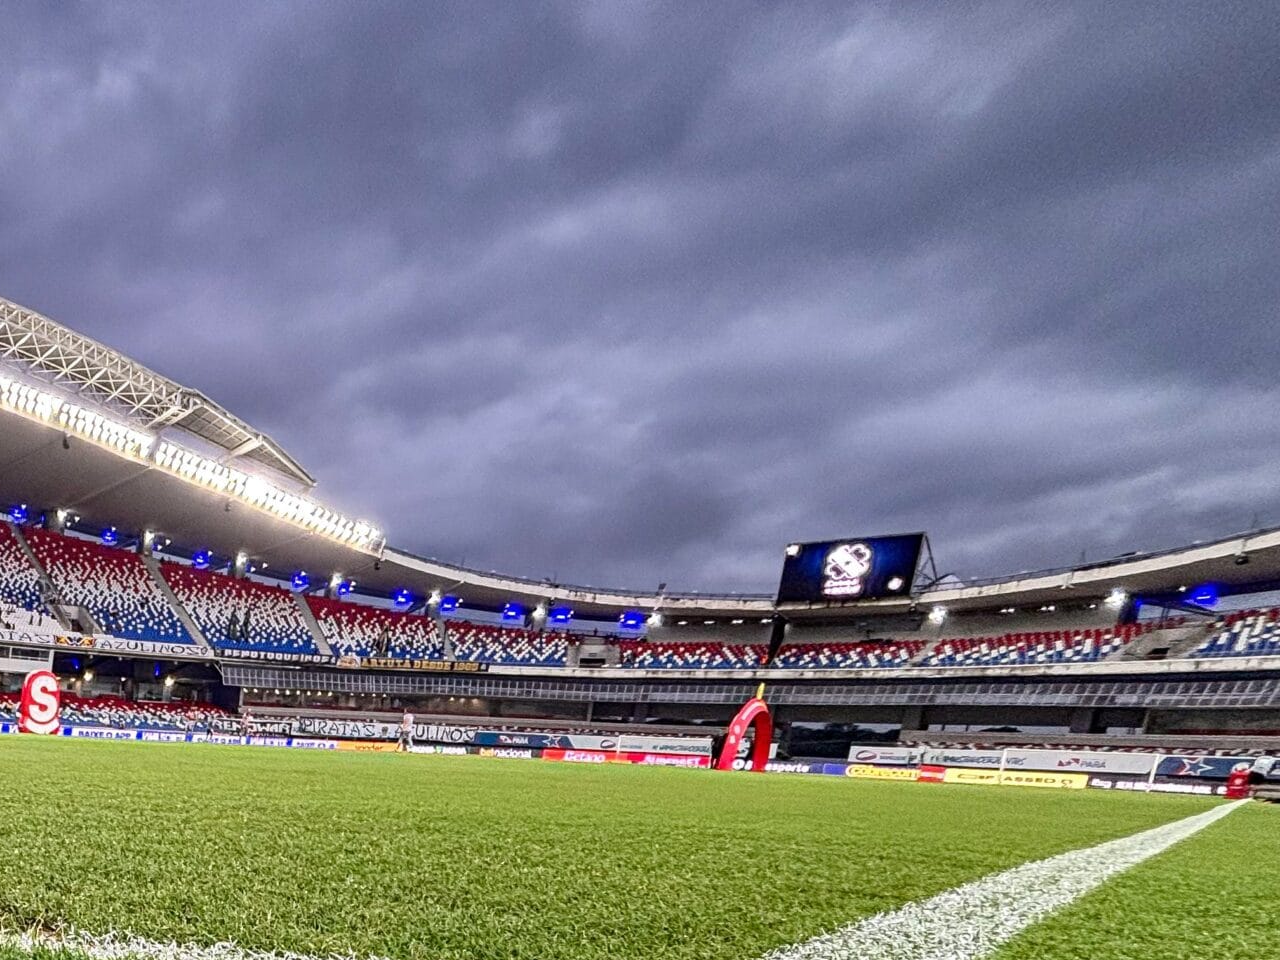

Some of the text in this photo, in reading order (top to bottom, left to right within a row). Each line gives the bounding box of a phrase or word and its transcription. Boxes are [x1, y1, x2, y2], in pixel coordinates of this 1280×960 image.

[100, 639, 199, 656] AZULINOS
[29, 675, 58, 723] S
[302, 718, 375, 737] PIRATAS
